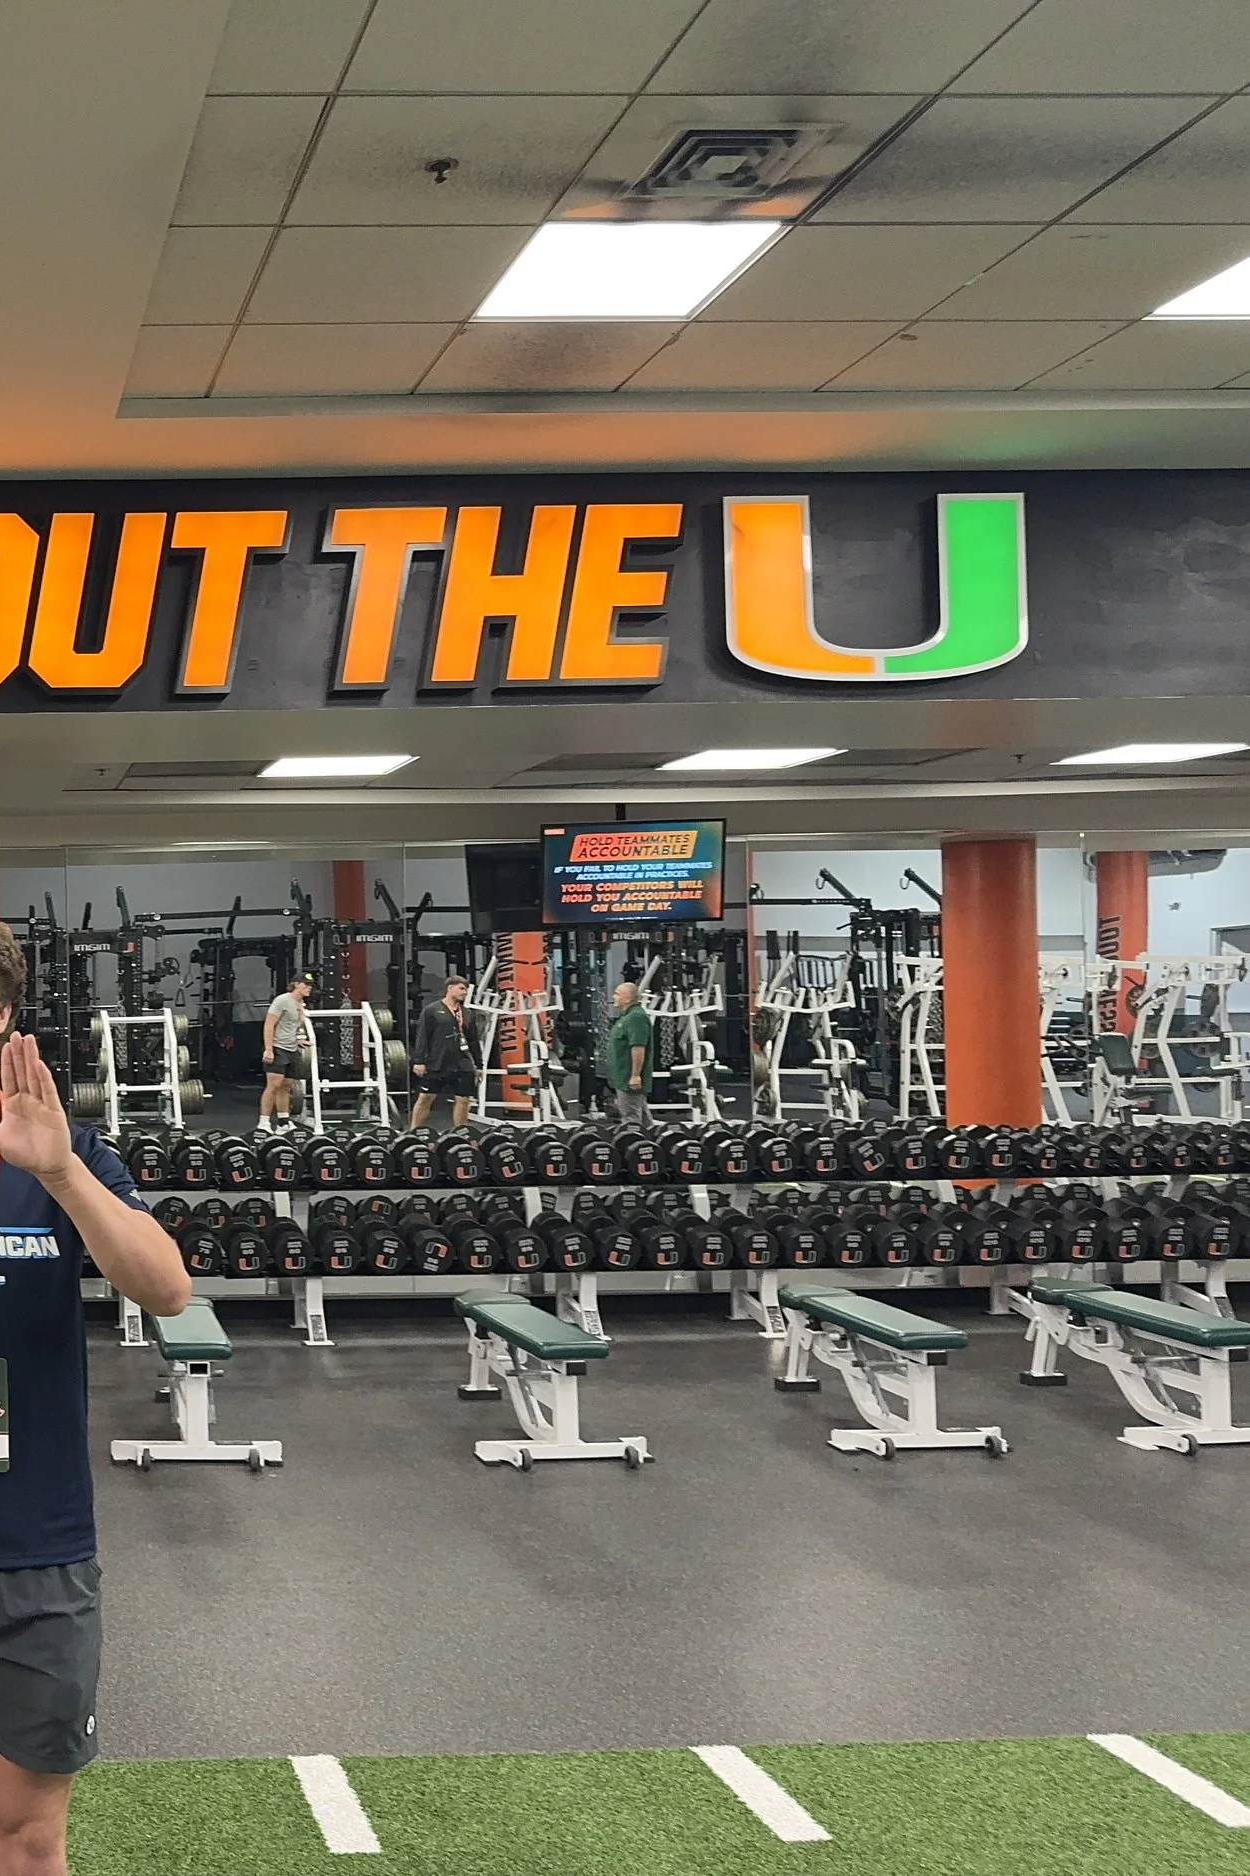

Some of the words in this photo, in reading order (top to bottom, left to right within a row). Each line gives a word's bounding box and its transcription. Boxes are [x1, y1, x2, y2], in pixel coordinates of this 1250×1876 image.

[324, 503, 685, 687] THE
[722, 492, 1029, 682] U
[580, 837, 613, 846] HOLD
[617, 834, 690, 845] TEAMMATES
[578, 845, 688, 858] ACCOUNTABLE
[616, 864, 639, 872] HOLD
[641, 863, 664, 871] YOUR
[561, 884, 593, 893] YOUR
[595, 881, 675, 891] COMPETITORS
[678, 880, 704, 889] WILL
[561, 894, 593, 903] HOLD
[596, 893, 620, 902] YOU
[622, 891, 702, 901] ACCOUNTABLE
[591, 903, 609, 912] ON
[611, 903, 645, 911] GAME
[647, 902, 672, 911] DAY.
